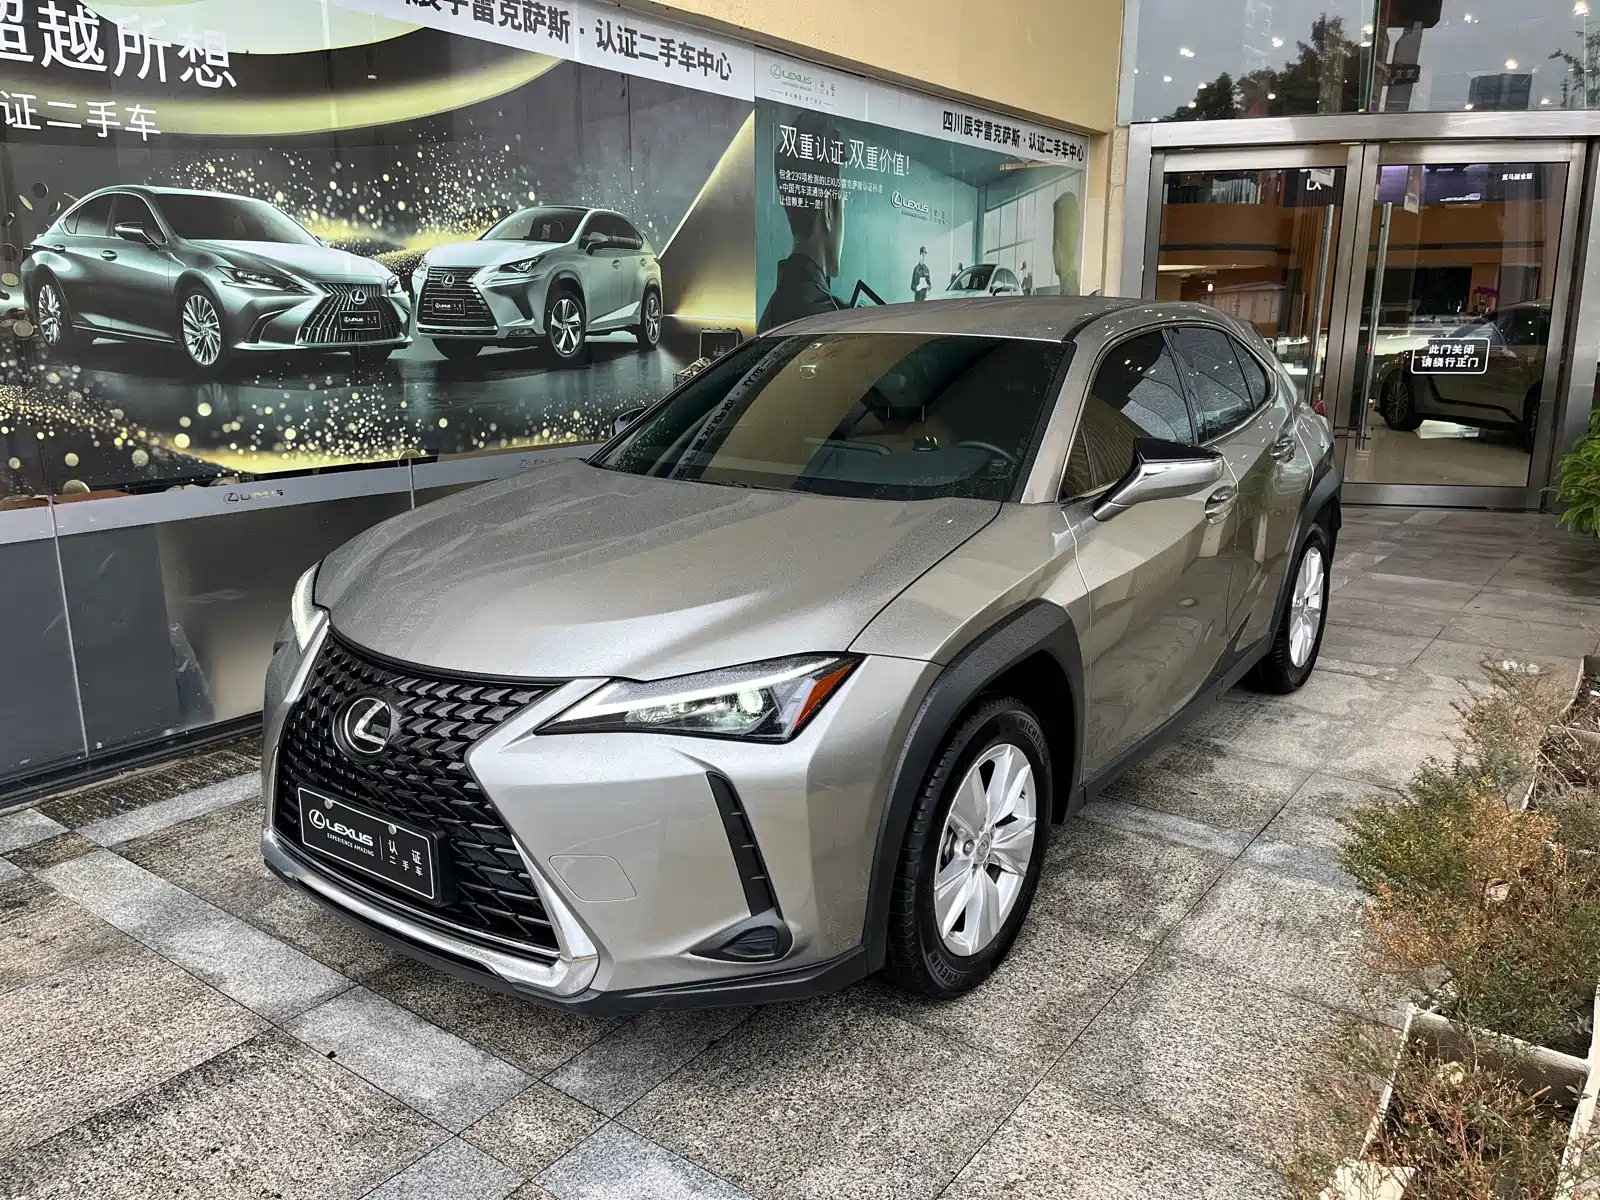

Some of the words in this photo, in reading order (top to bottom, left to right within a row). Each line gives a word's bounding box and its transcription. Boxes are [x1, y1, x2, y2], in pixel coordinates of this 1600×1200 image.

[782, 70, 812, 84] LEXUS
[942, 110, 1084, 162] 四川辰宇雷克萨斯·认证二手车中心
[902, 198, 928, 213] LEXUS
[1428, 344, 1475, 355] 此门关闭
[1421, 357, 1479, 367] 请绕行正门
[325, 818, 374, 847] LEXUS
[326, 832, 353, 849] EXPERIENCE
[353, 844, 375, 857] AMAZING
[928, 952, 963, 986] ICHELIN
